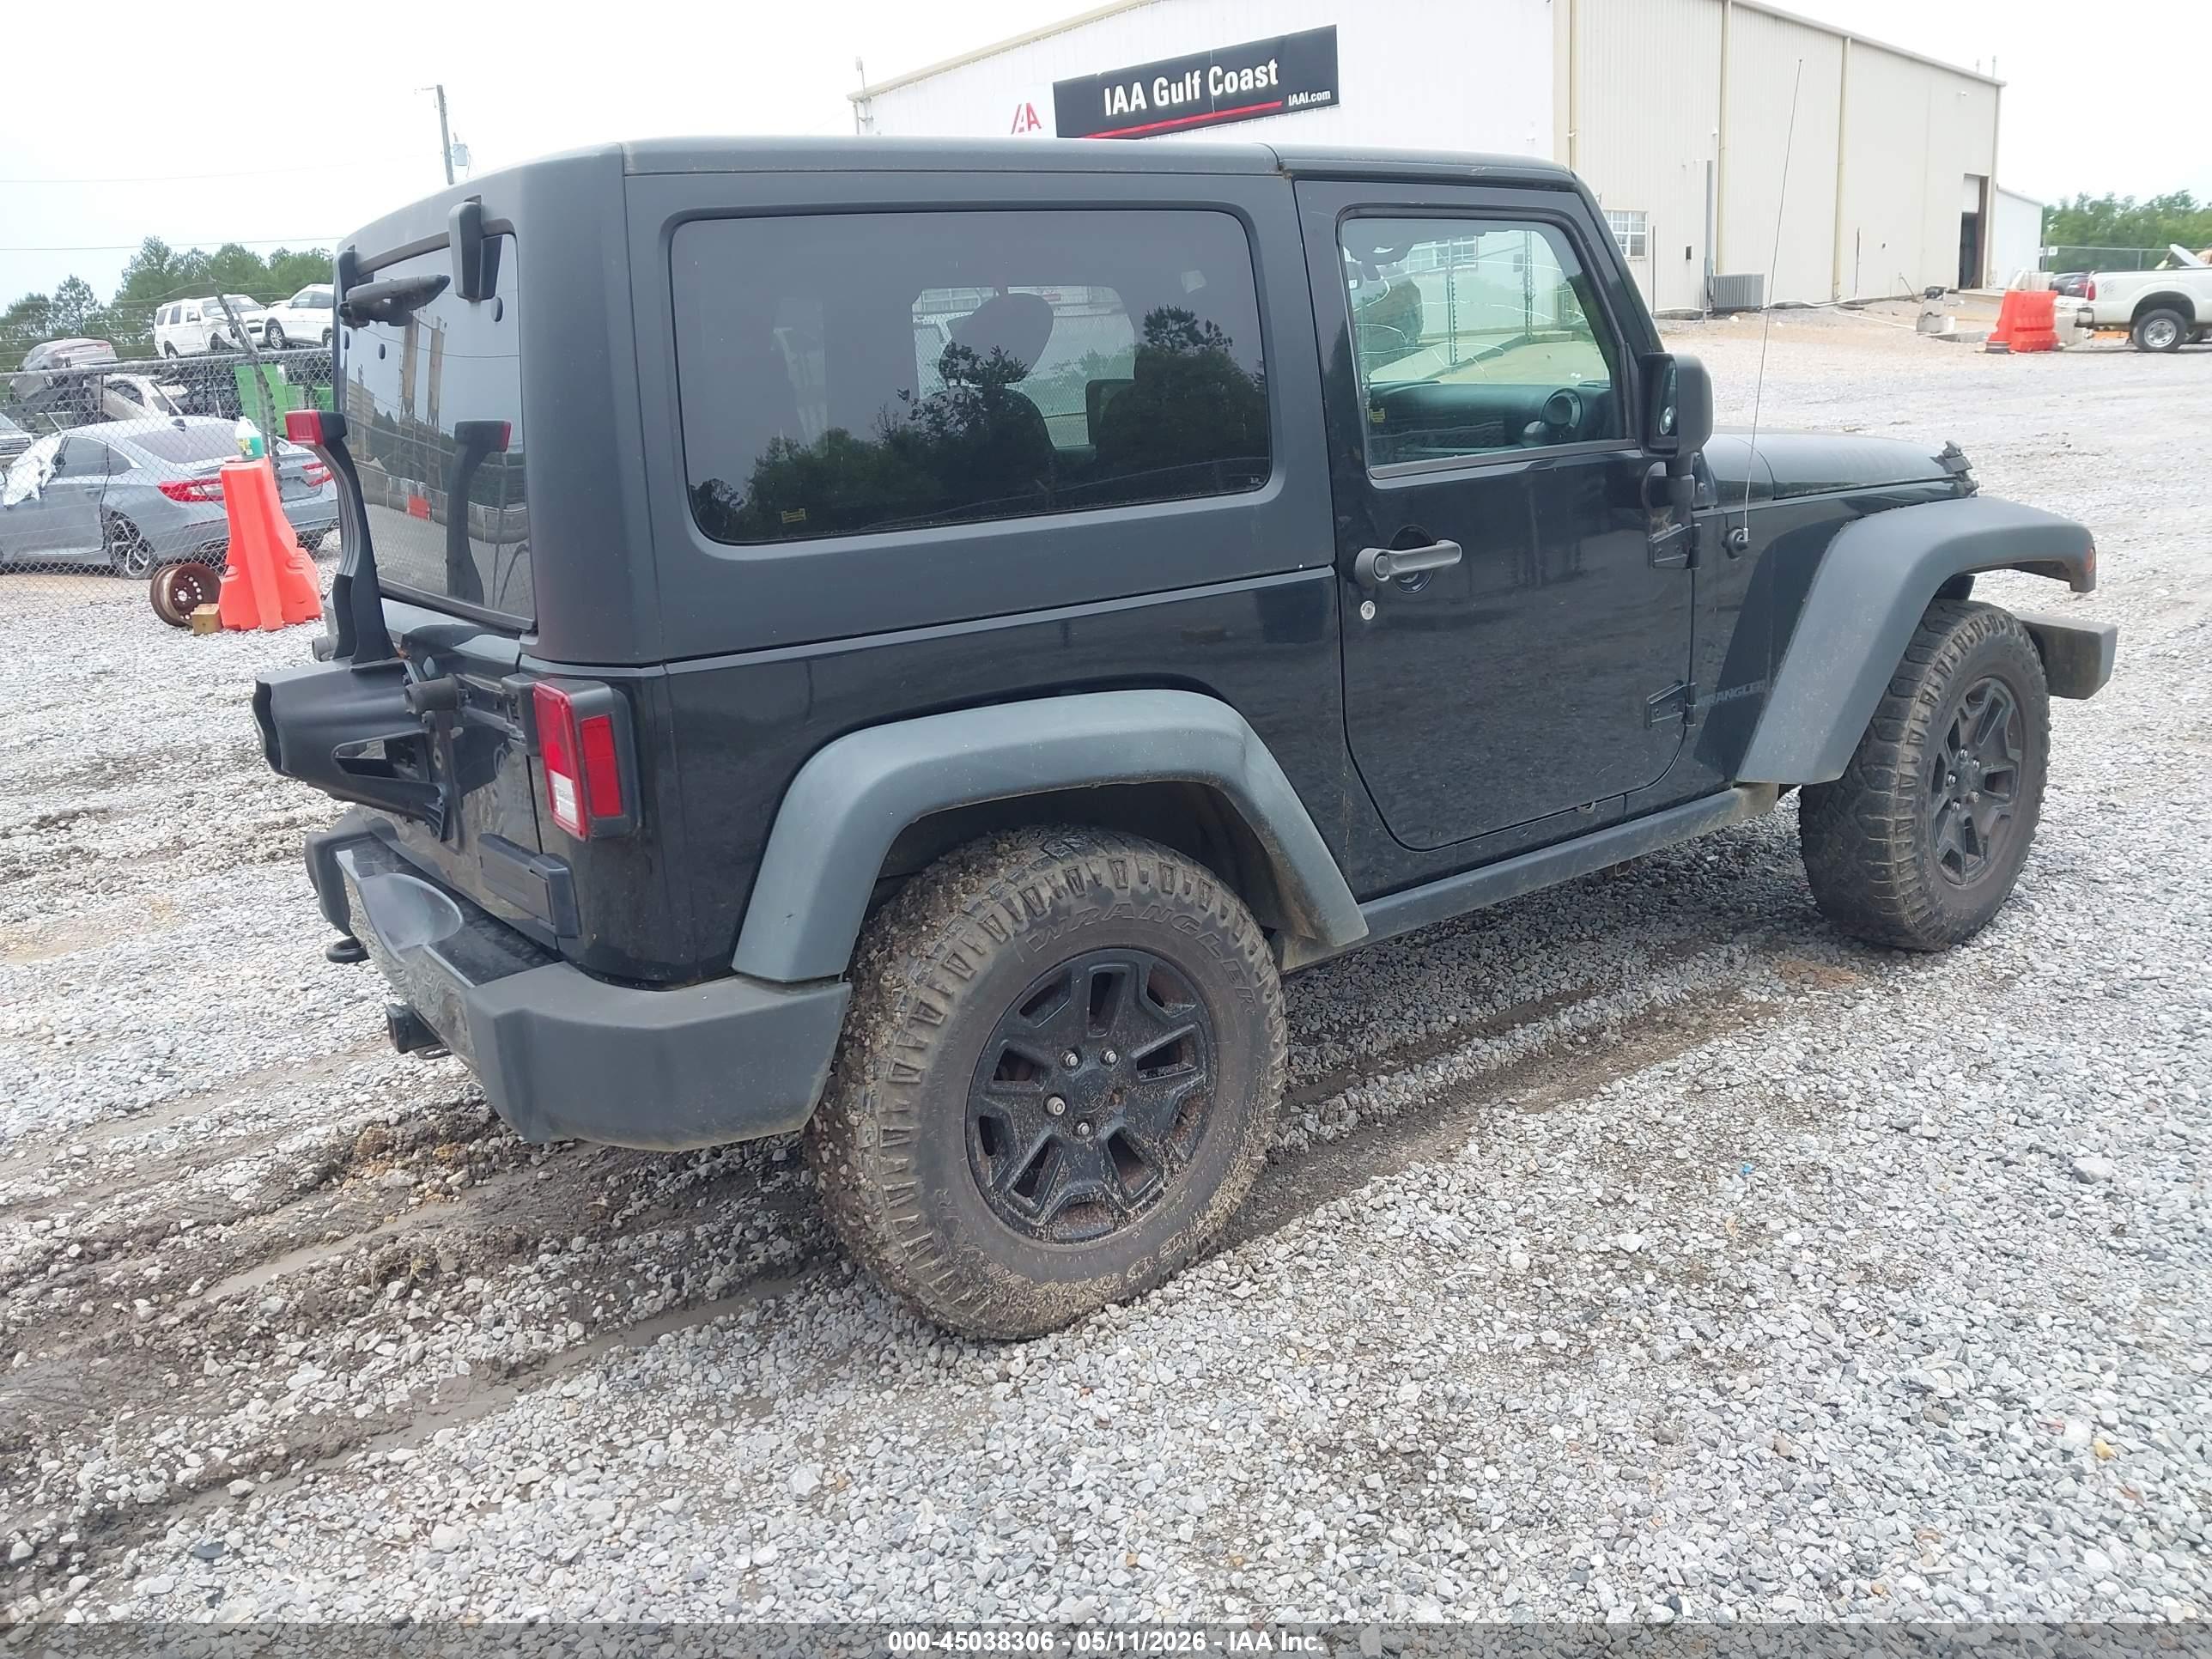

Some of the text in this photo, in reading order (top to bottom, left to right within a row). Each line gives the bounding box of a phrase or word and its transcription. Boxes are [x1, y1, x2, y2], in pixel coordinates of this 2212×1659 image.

[1104, 58, 1279, 116] IAA Gulf Coast
[1025, 902, 1259, 1017] WRANGLER
